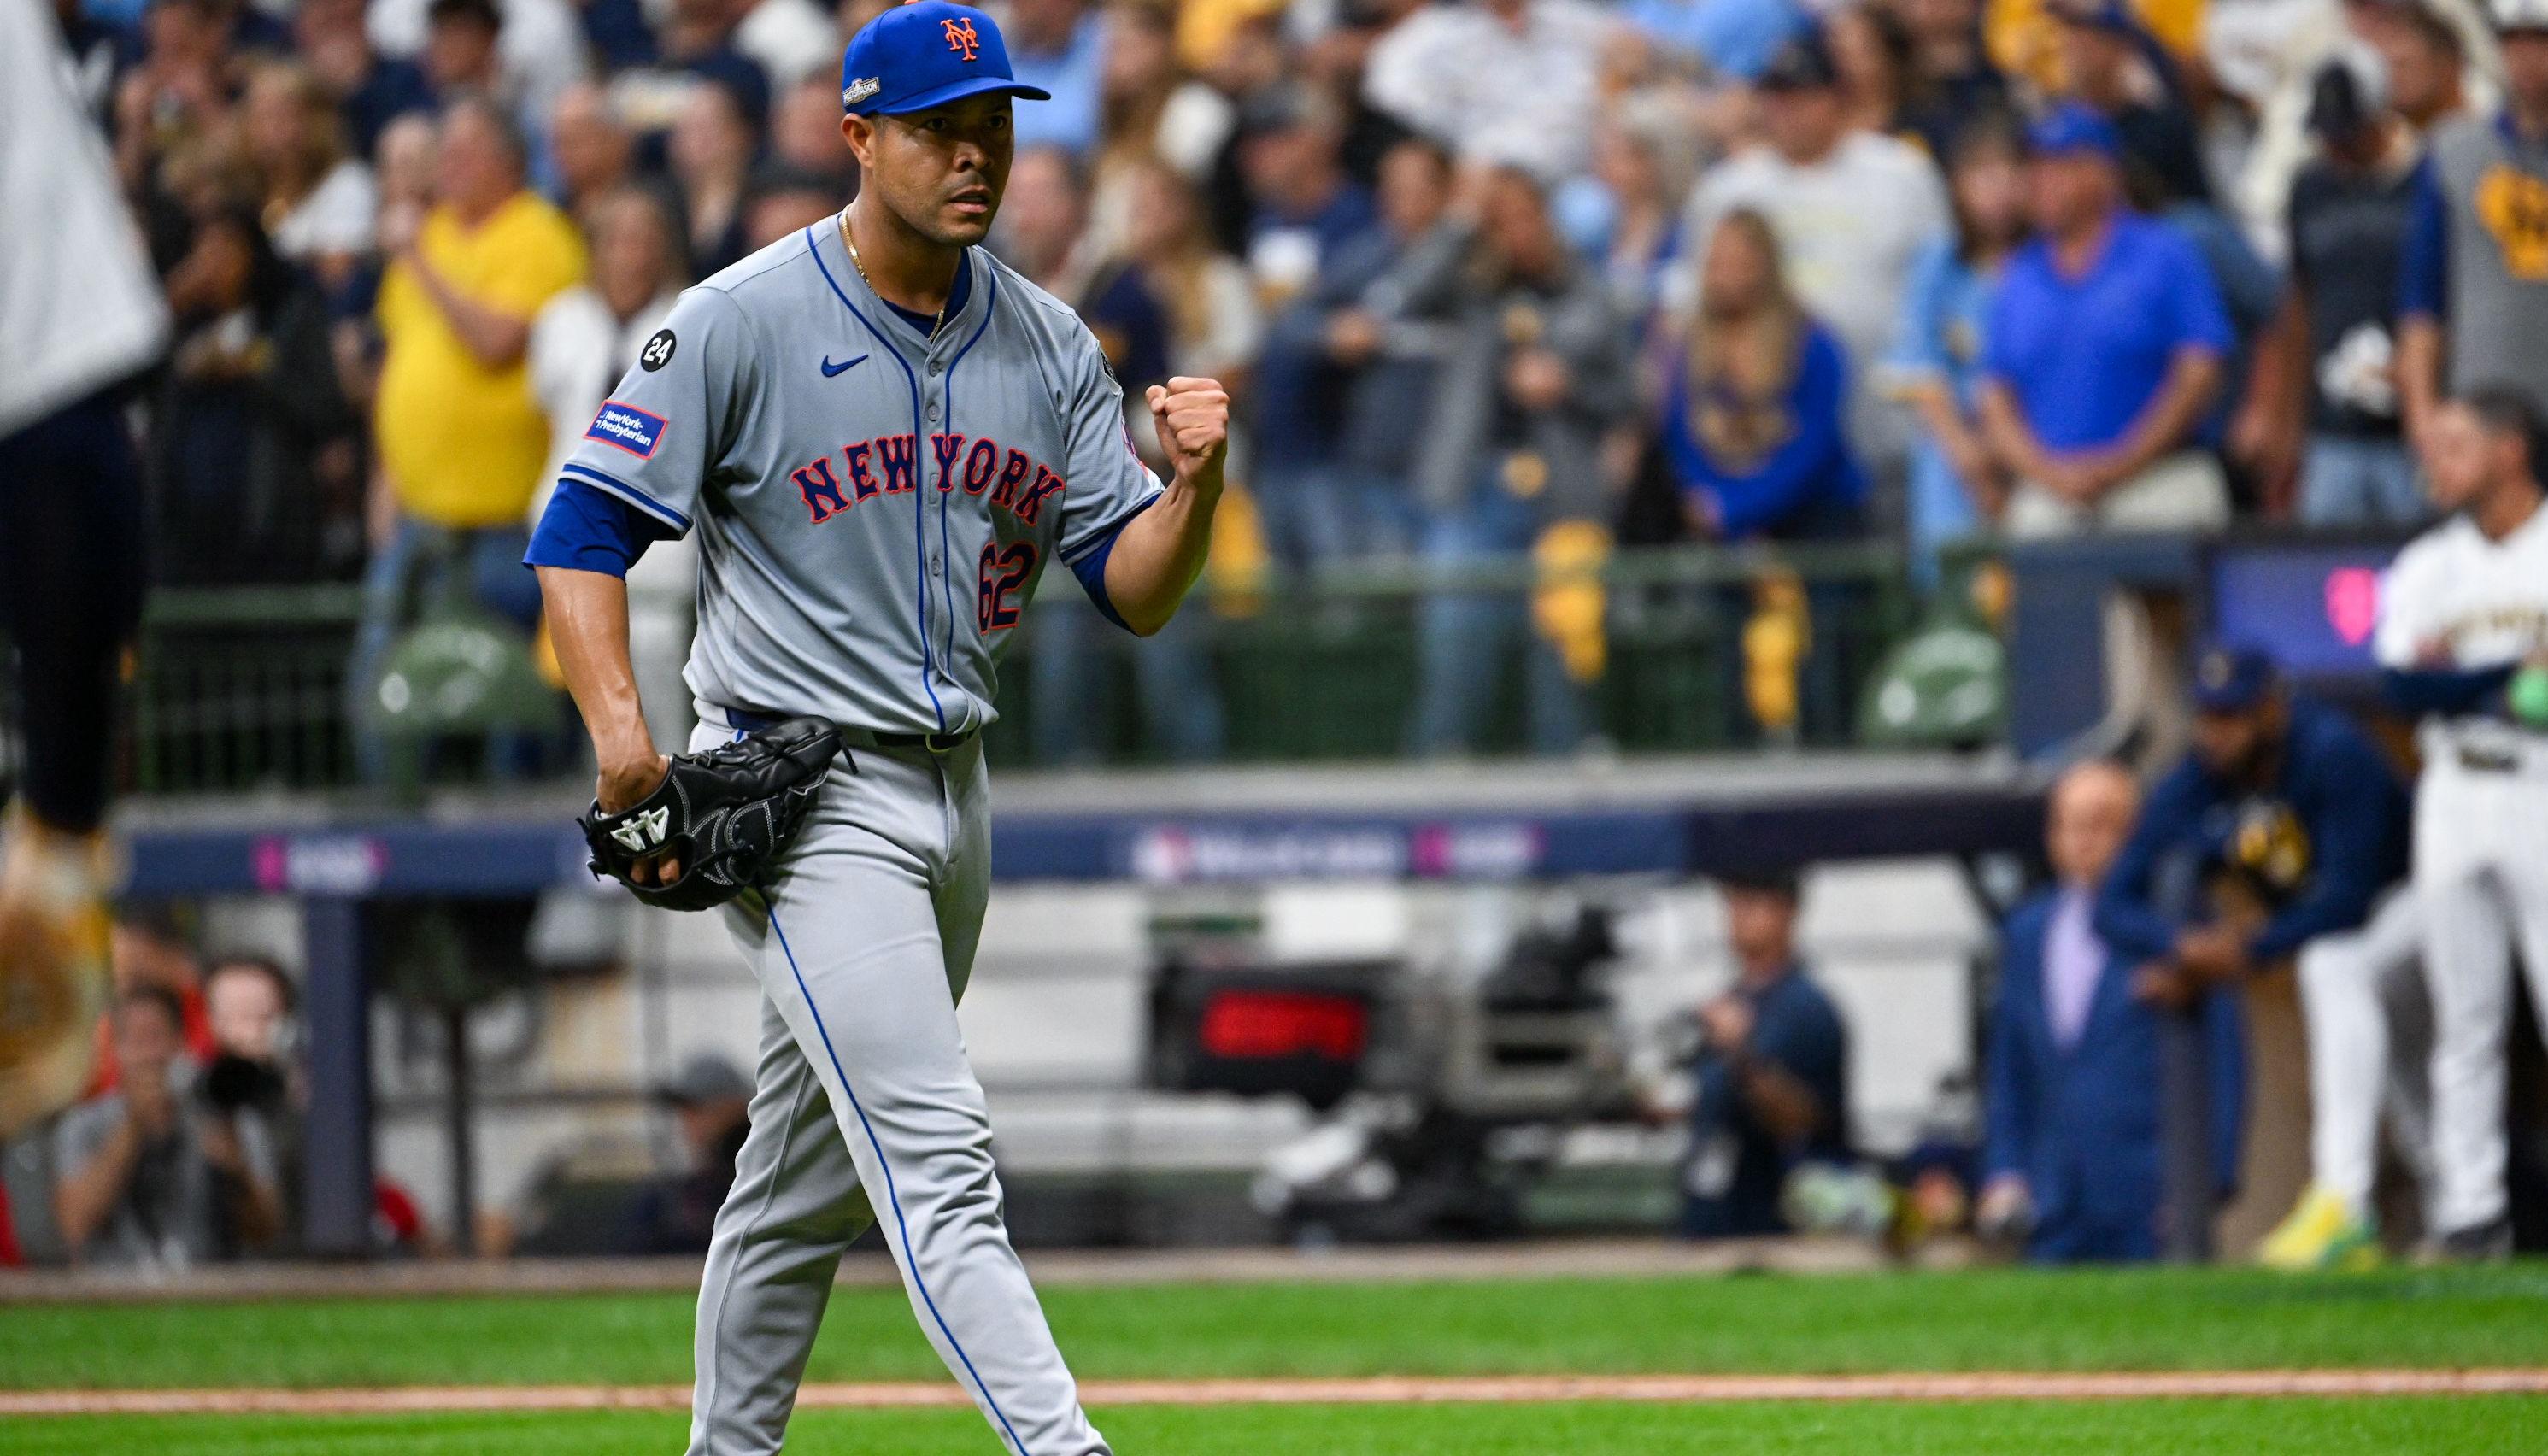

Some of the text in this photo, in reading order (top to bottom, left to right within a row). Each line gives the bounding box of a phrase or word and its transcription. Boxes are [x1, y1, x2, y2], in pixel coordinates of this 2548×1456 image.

[643, 337, 673, 365] 24
[599, 420, 652, 446] Presbyterian
[791, 434, 916, 524] NEW
[931, 433, 1066, 526] YORK
[978, 541, 1039, 636] 62
